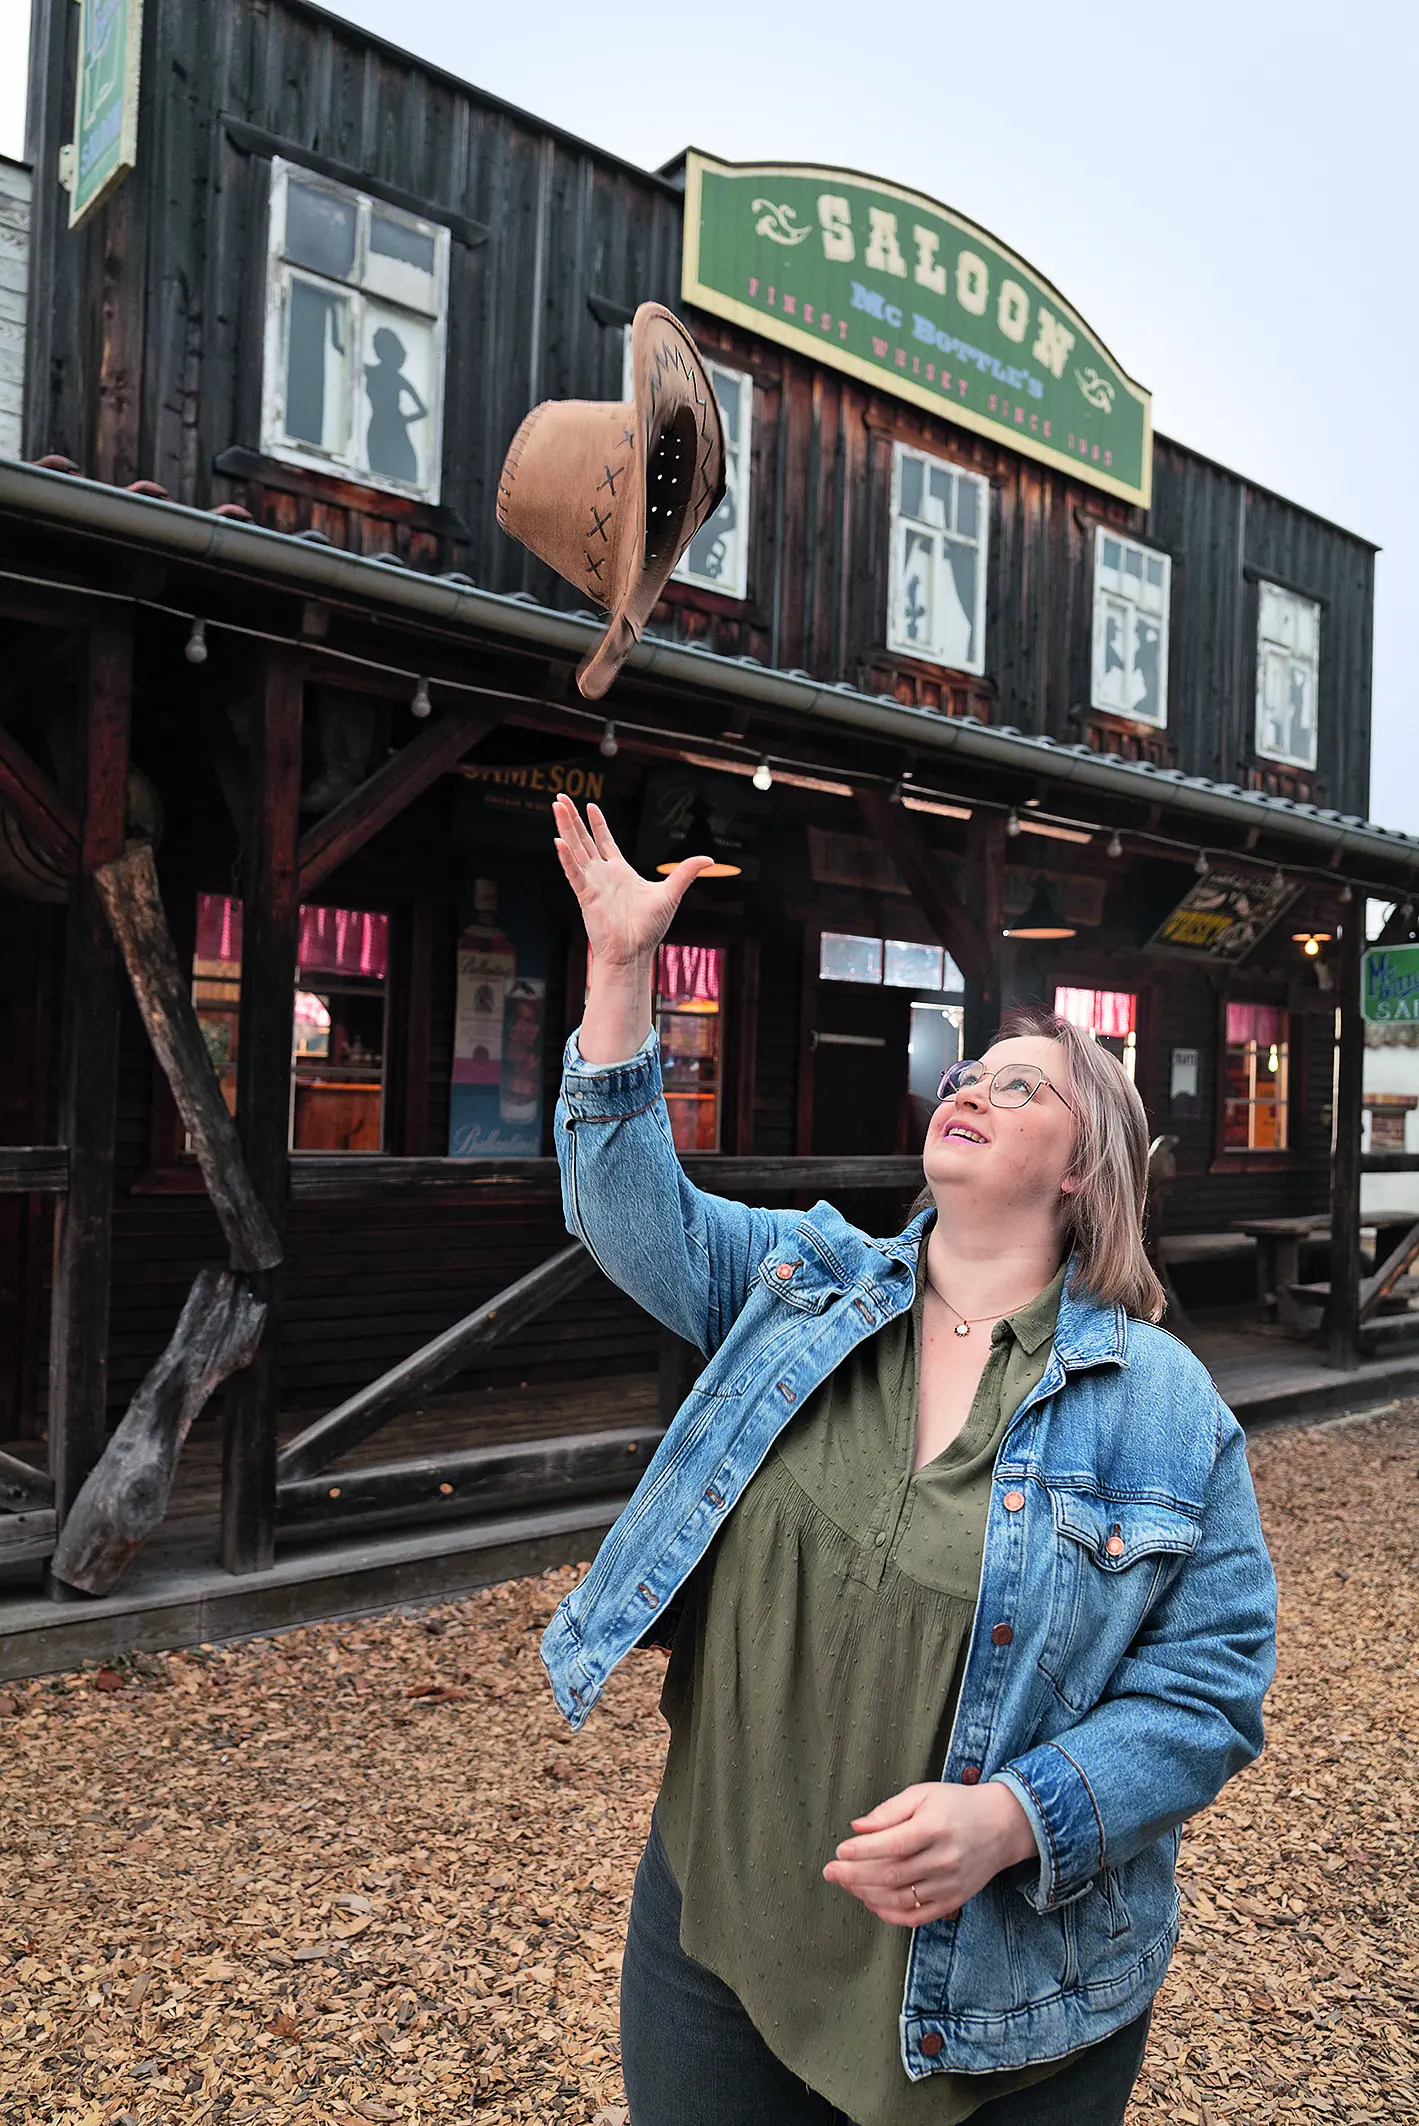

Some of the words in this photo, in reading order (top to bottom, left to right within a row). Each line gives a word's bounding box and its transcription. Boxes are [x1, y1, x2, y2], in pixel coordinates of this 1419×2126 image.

[748, 277, 848, 340] FINEST
[987, 393, 1052, 438] SINCE
[817, 193, 1075, 379] SALOON
[850, 281, 903, 328] Mc
